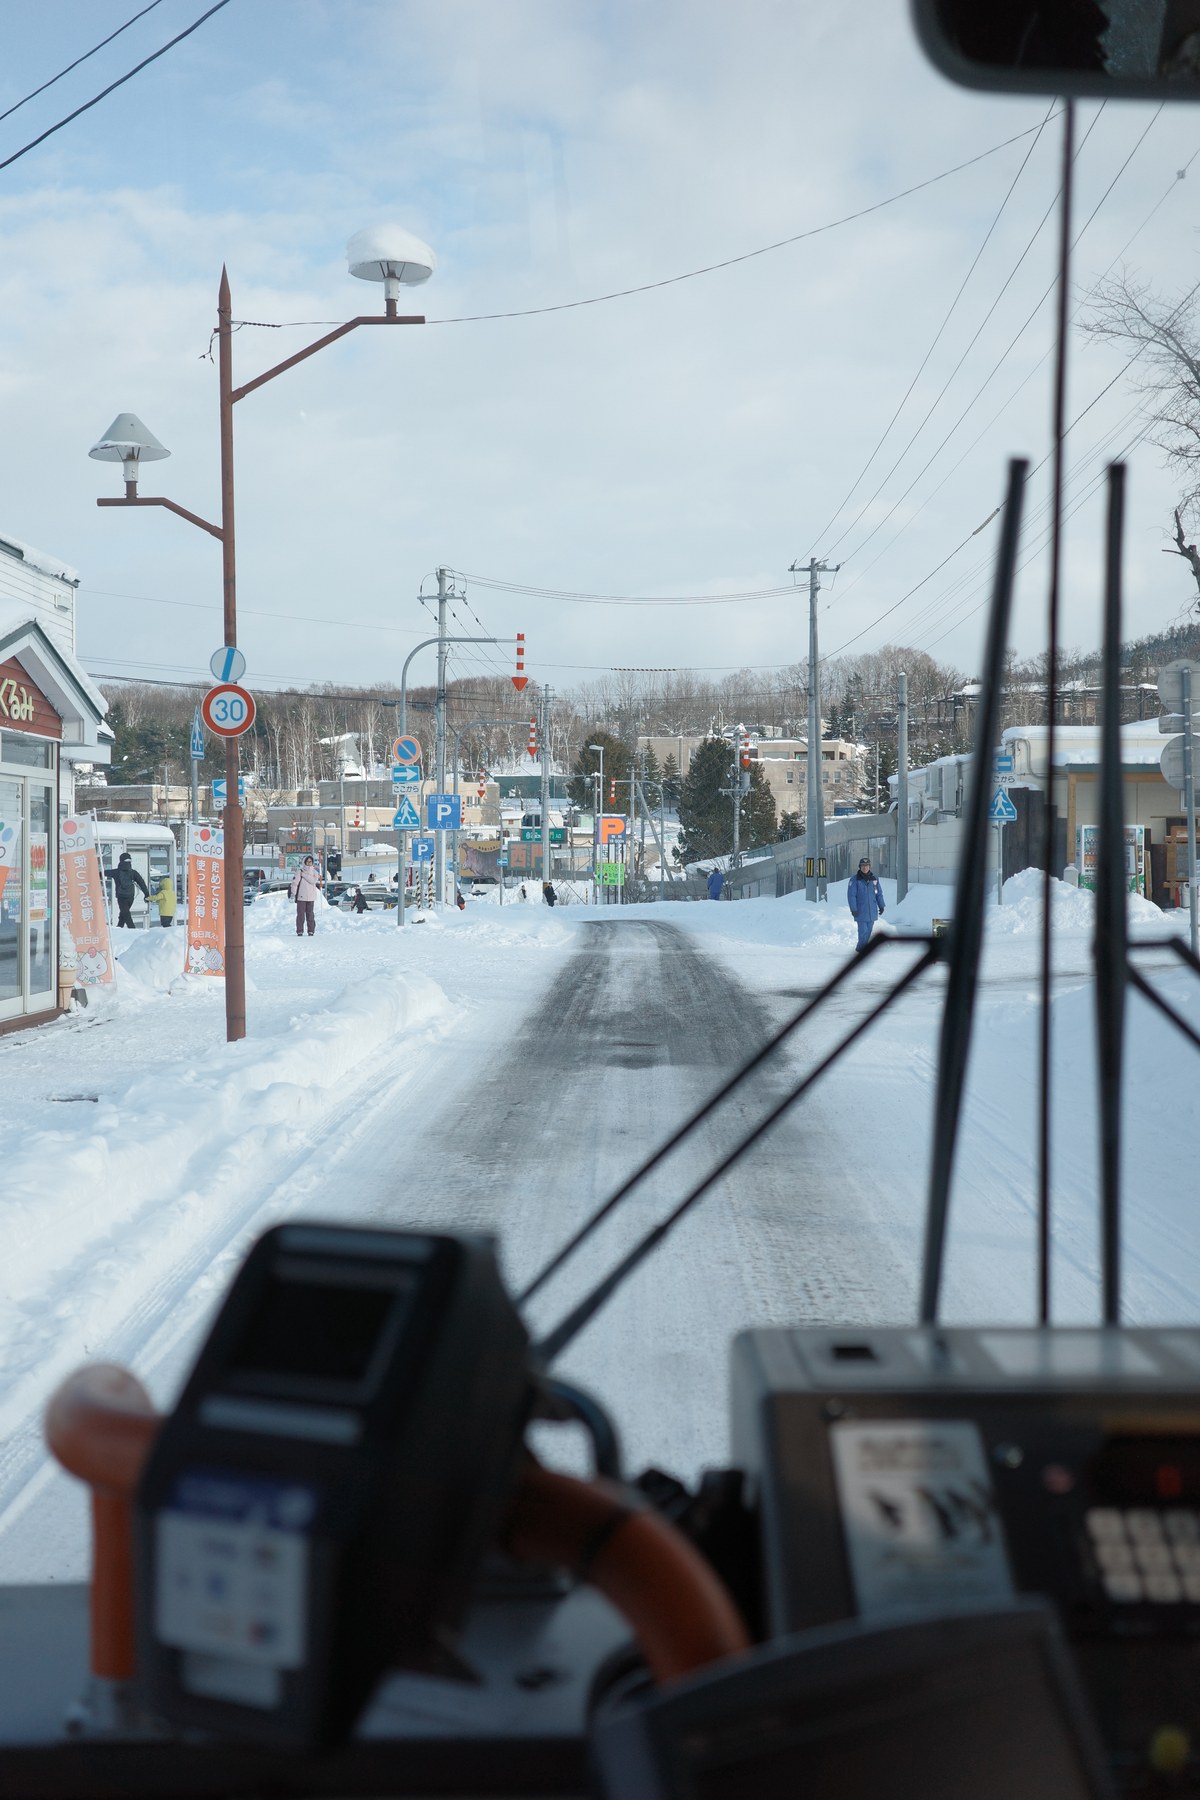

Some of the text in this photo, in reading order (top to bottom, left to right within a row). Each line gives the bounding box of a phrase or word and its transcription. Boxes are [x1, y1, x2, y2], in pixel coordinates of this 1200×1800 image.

[215, 699, 243, 721] 30
[993, 775, 1015, 783] こから
[437, 804, 452, 821] P
[435, 821, 453, 829] 入口
[598, 818, 625, 844] P
[418, 844, 428, 856] P
